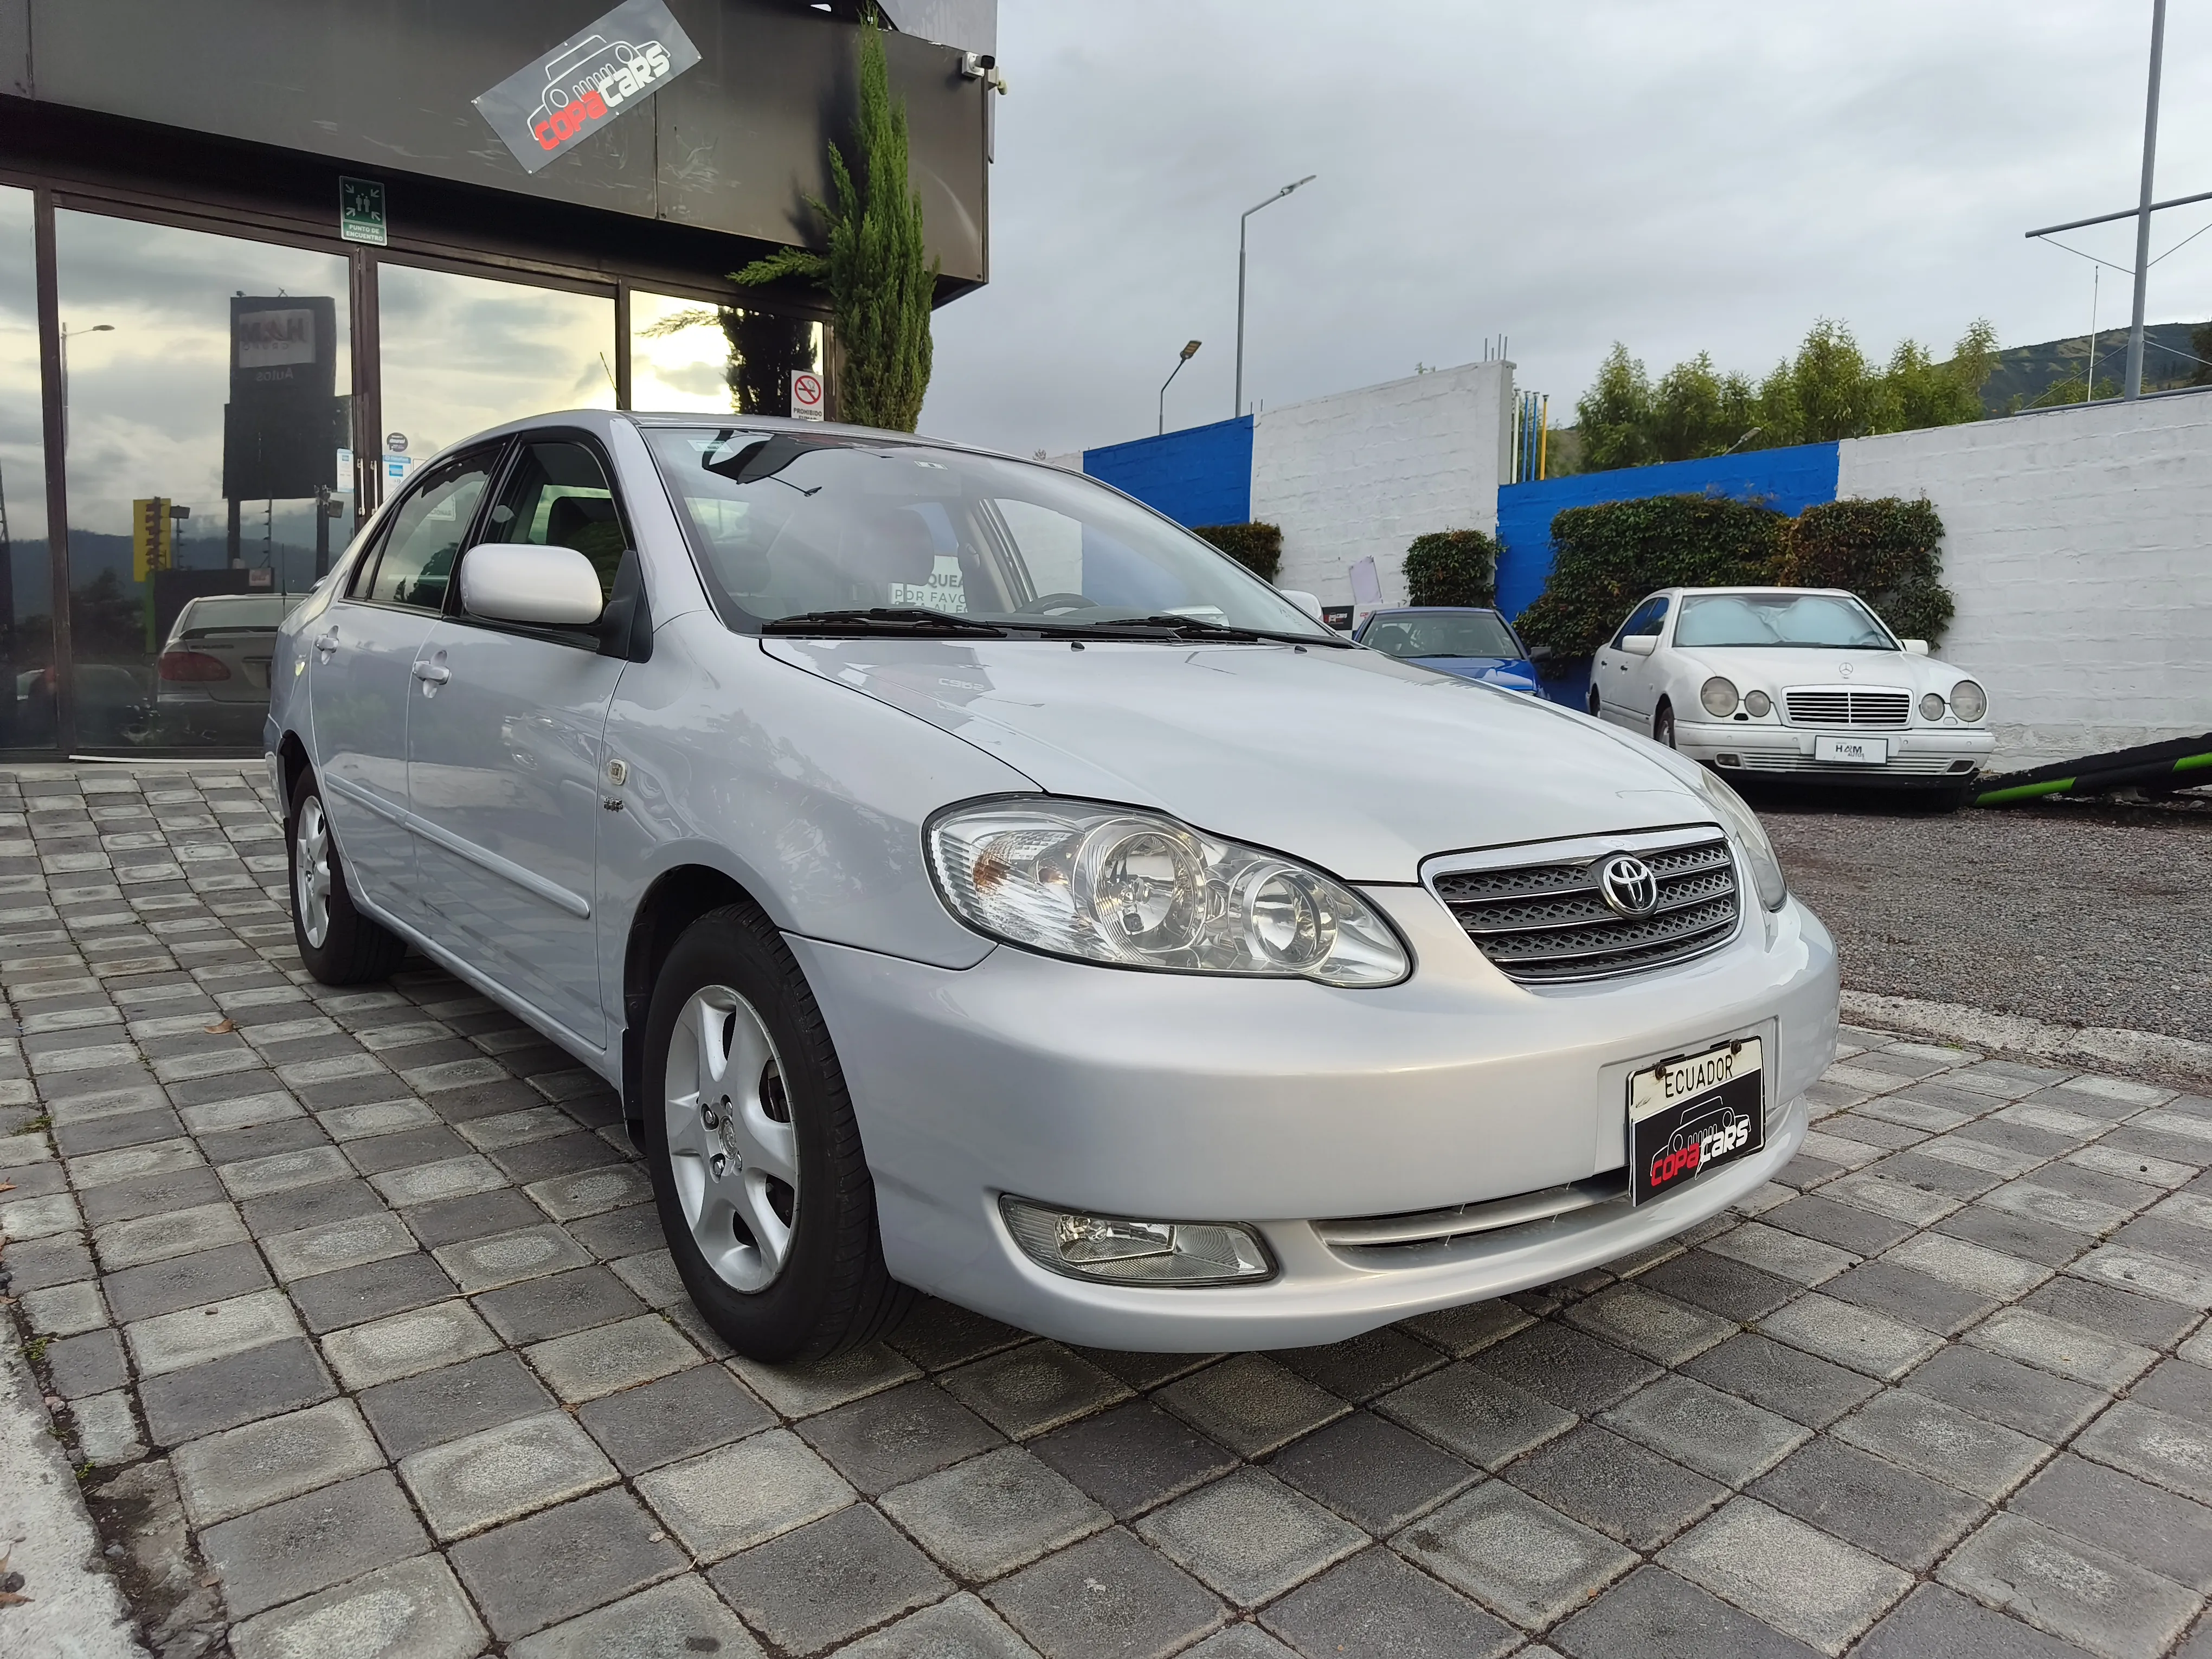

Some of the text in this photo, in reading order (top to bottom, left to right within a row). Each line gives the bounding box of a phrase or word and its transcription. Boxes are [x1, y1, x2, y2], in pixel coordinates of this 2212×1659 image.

[349, 224, 370, 233] PUNTO
[346, 230, 383, 242] ENCUENTRO
[793, 407, 822, 416] PROHIBIDO
[895, 589, 924, 601] POR
[930, 592, 966, 604] FAVO
[1664, 1054, 1733, 1098] ECUADOR
